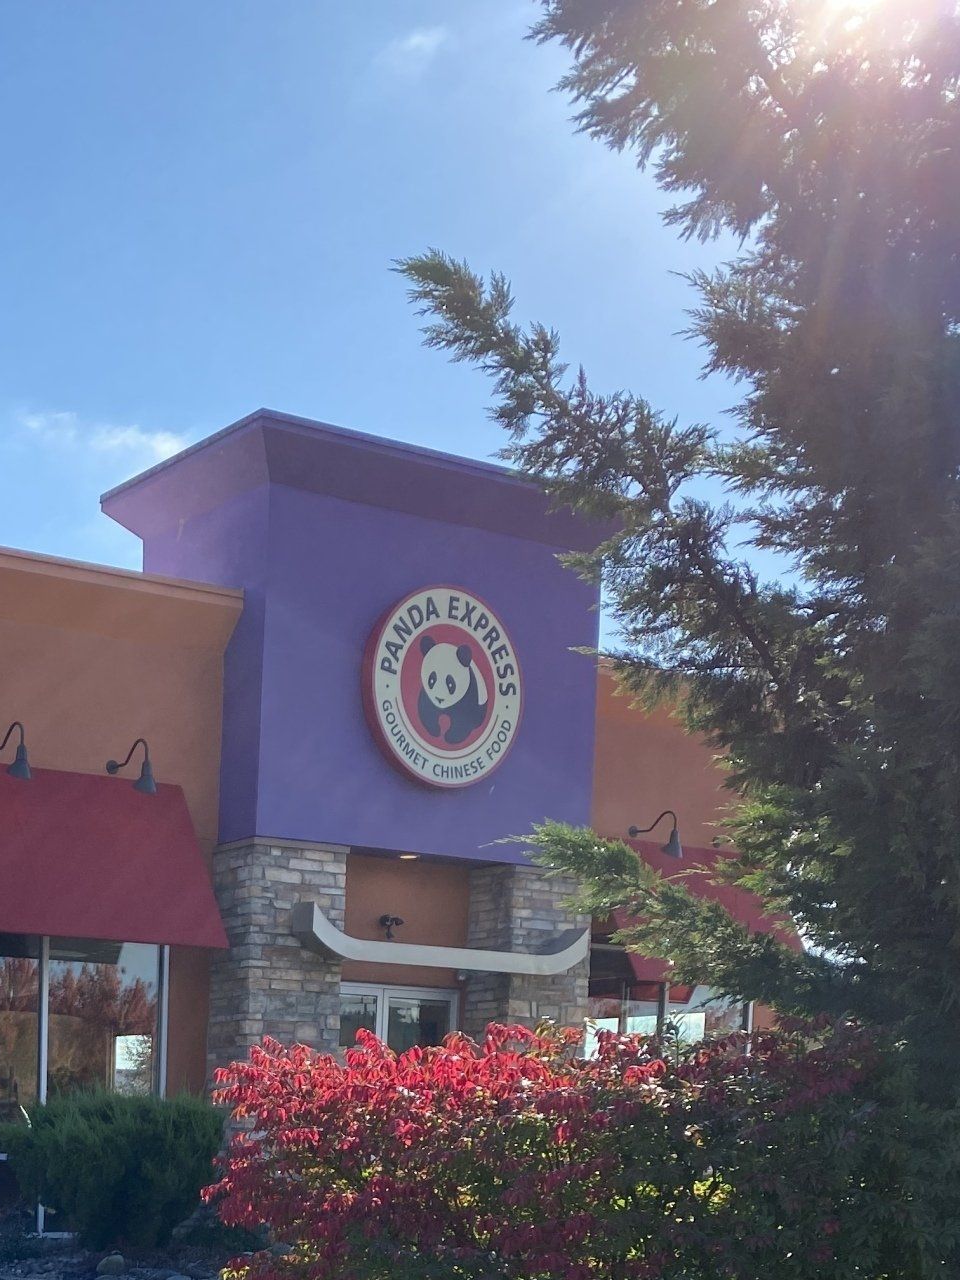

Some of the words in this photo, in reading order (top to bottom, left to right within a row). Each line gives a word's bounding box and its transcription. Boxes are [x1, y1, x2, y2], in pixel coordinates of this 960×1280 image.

[381, 597, 440, 675] PANDA
[448, 596, 516, 697] EXPRESS
[382, 700, 429, 770] GOURMET
[433, 757, 485, 778] CHINESE
[487, 719, 512, 760] FOOD
